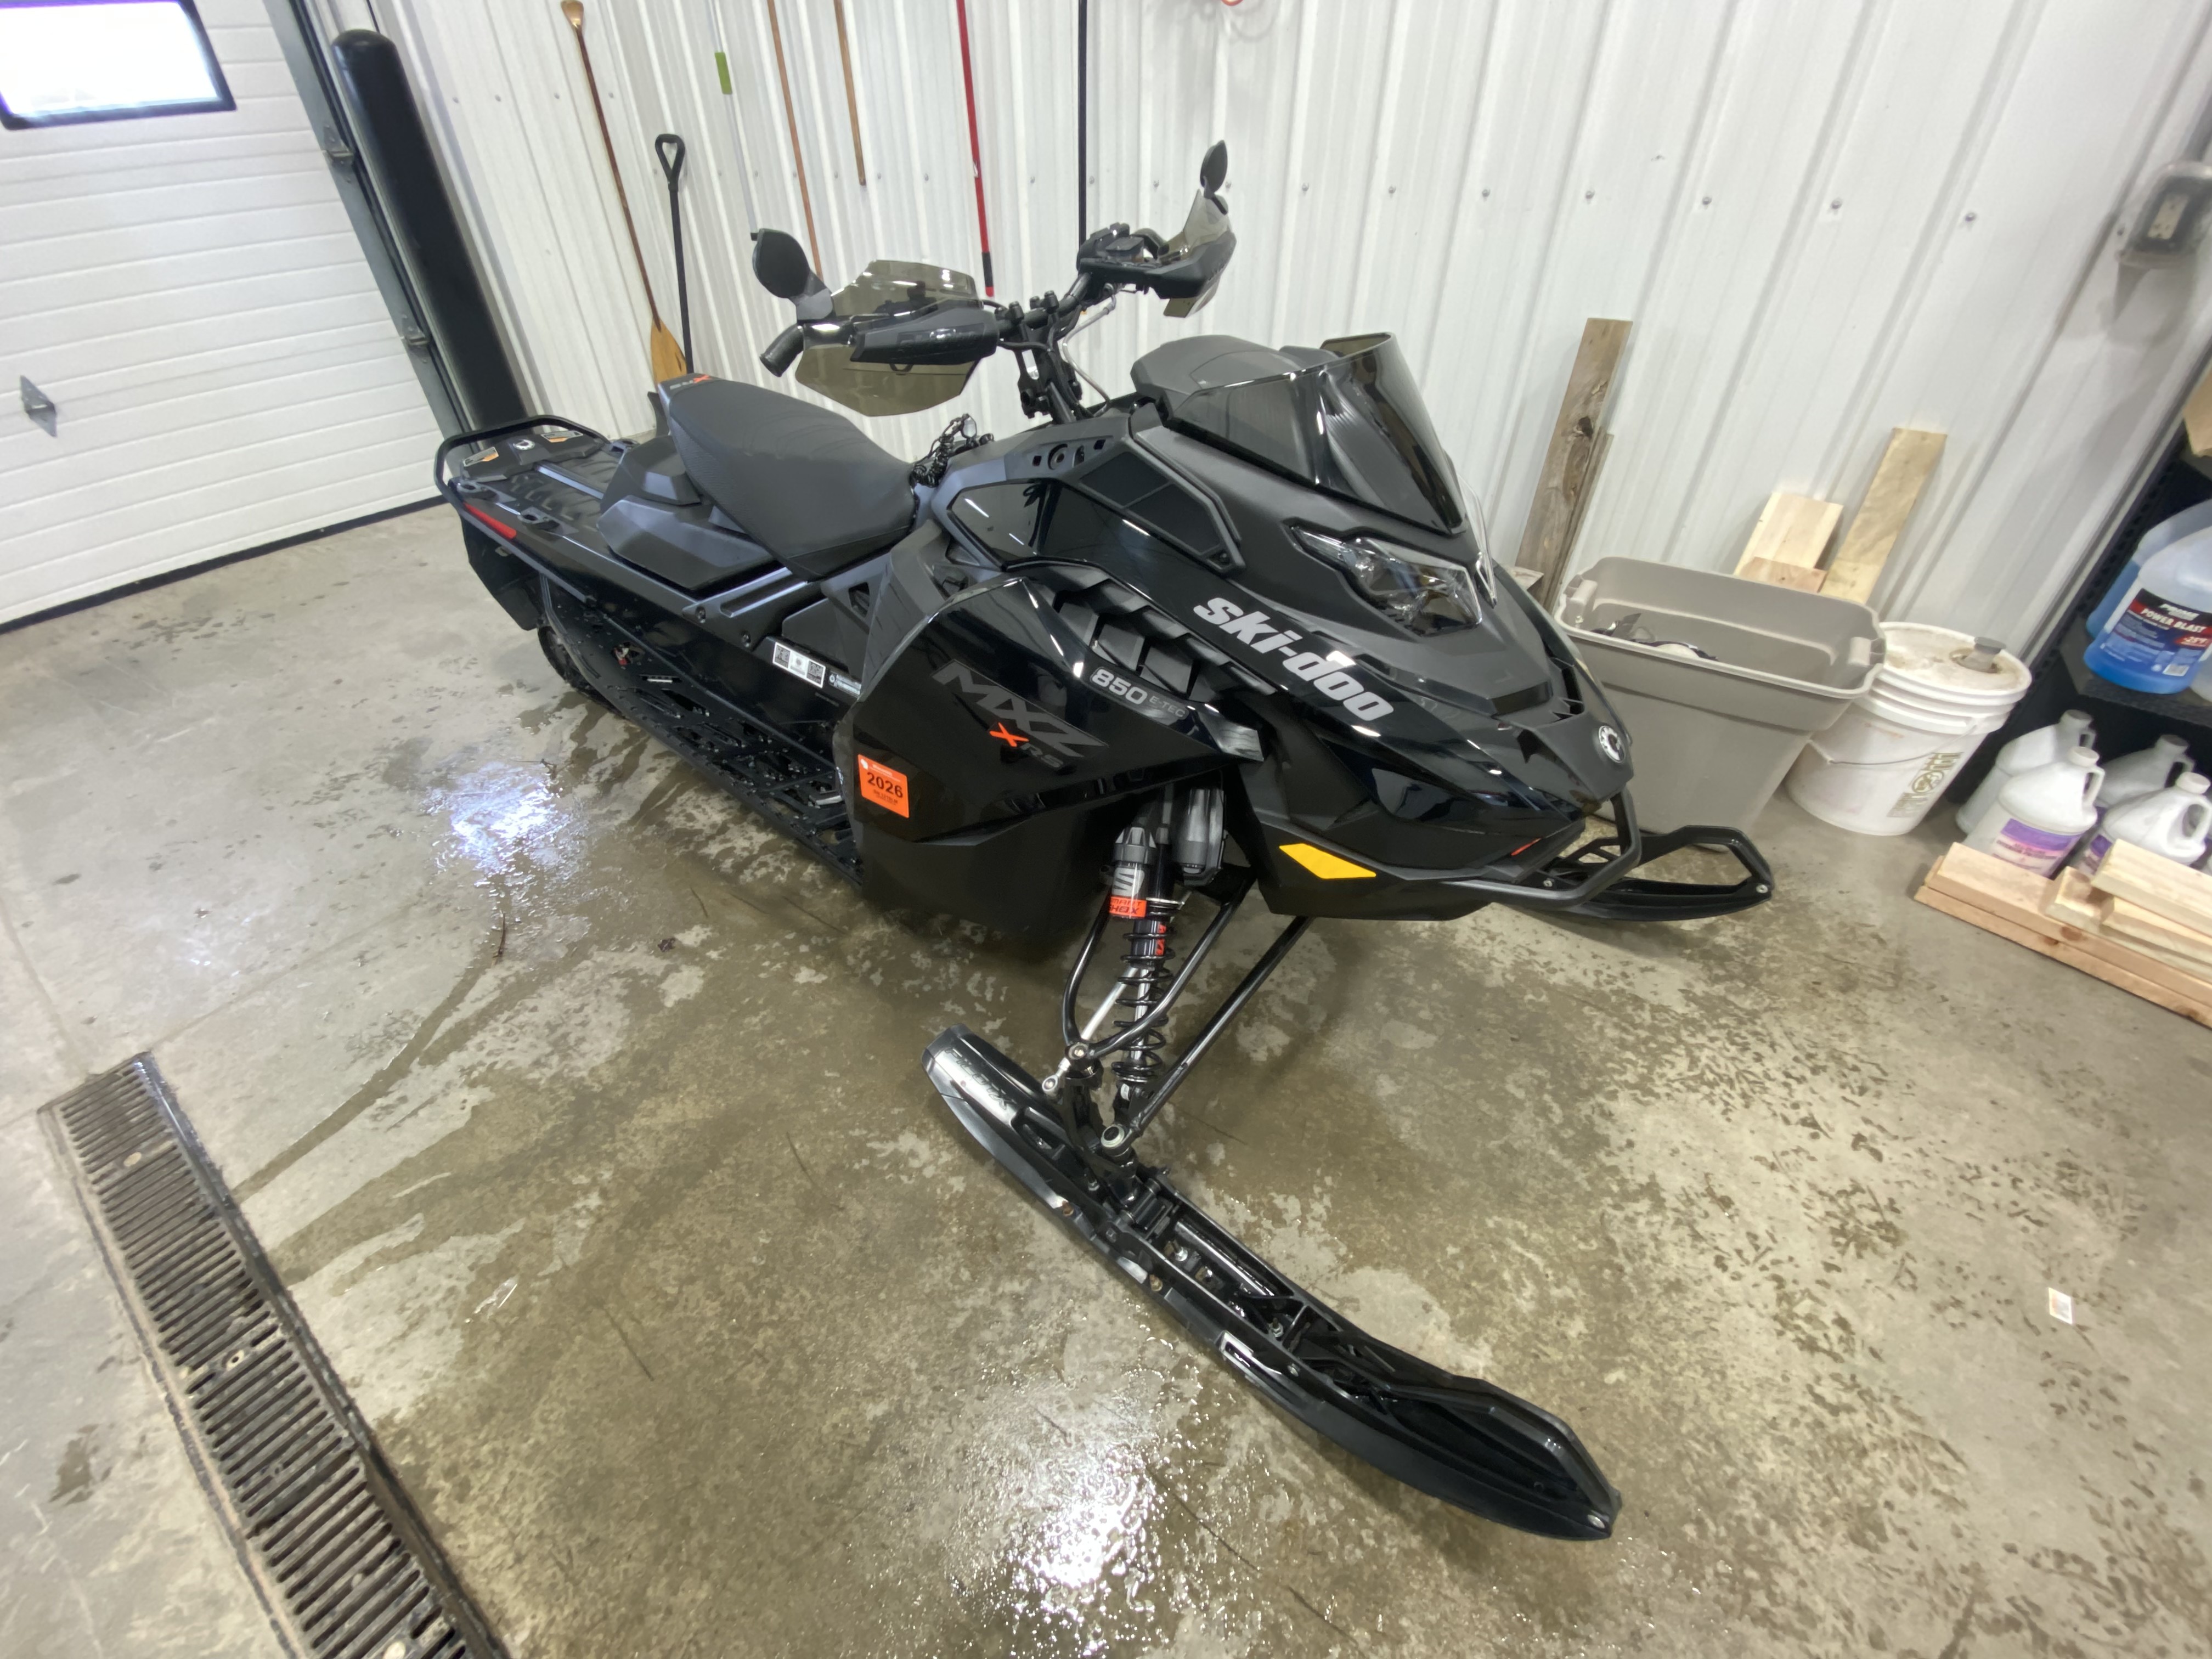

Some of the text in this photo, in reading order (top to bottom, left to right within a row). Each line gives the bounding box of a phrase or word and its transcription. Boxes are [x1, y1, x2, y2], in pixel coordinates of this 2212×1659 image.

[2141, 608, 2174, 625] POWER
[2173, 621, 2207, 633] BLAST
[1193, 597, 1394, 721] ski-doo
[932, 659, 1105, 758] MXZ
[1092, 668, 1186, 718] 850 E-TEC
[989, 722, 1064, 768] X RS
[867, 772, 903, 798] 2026
